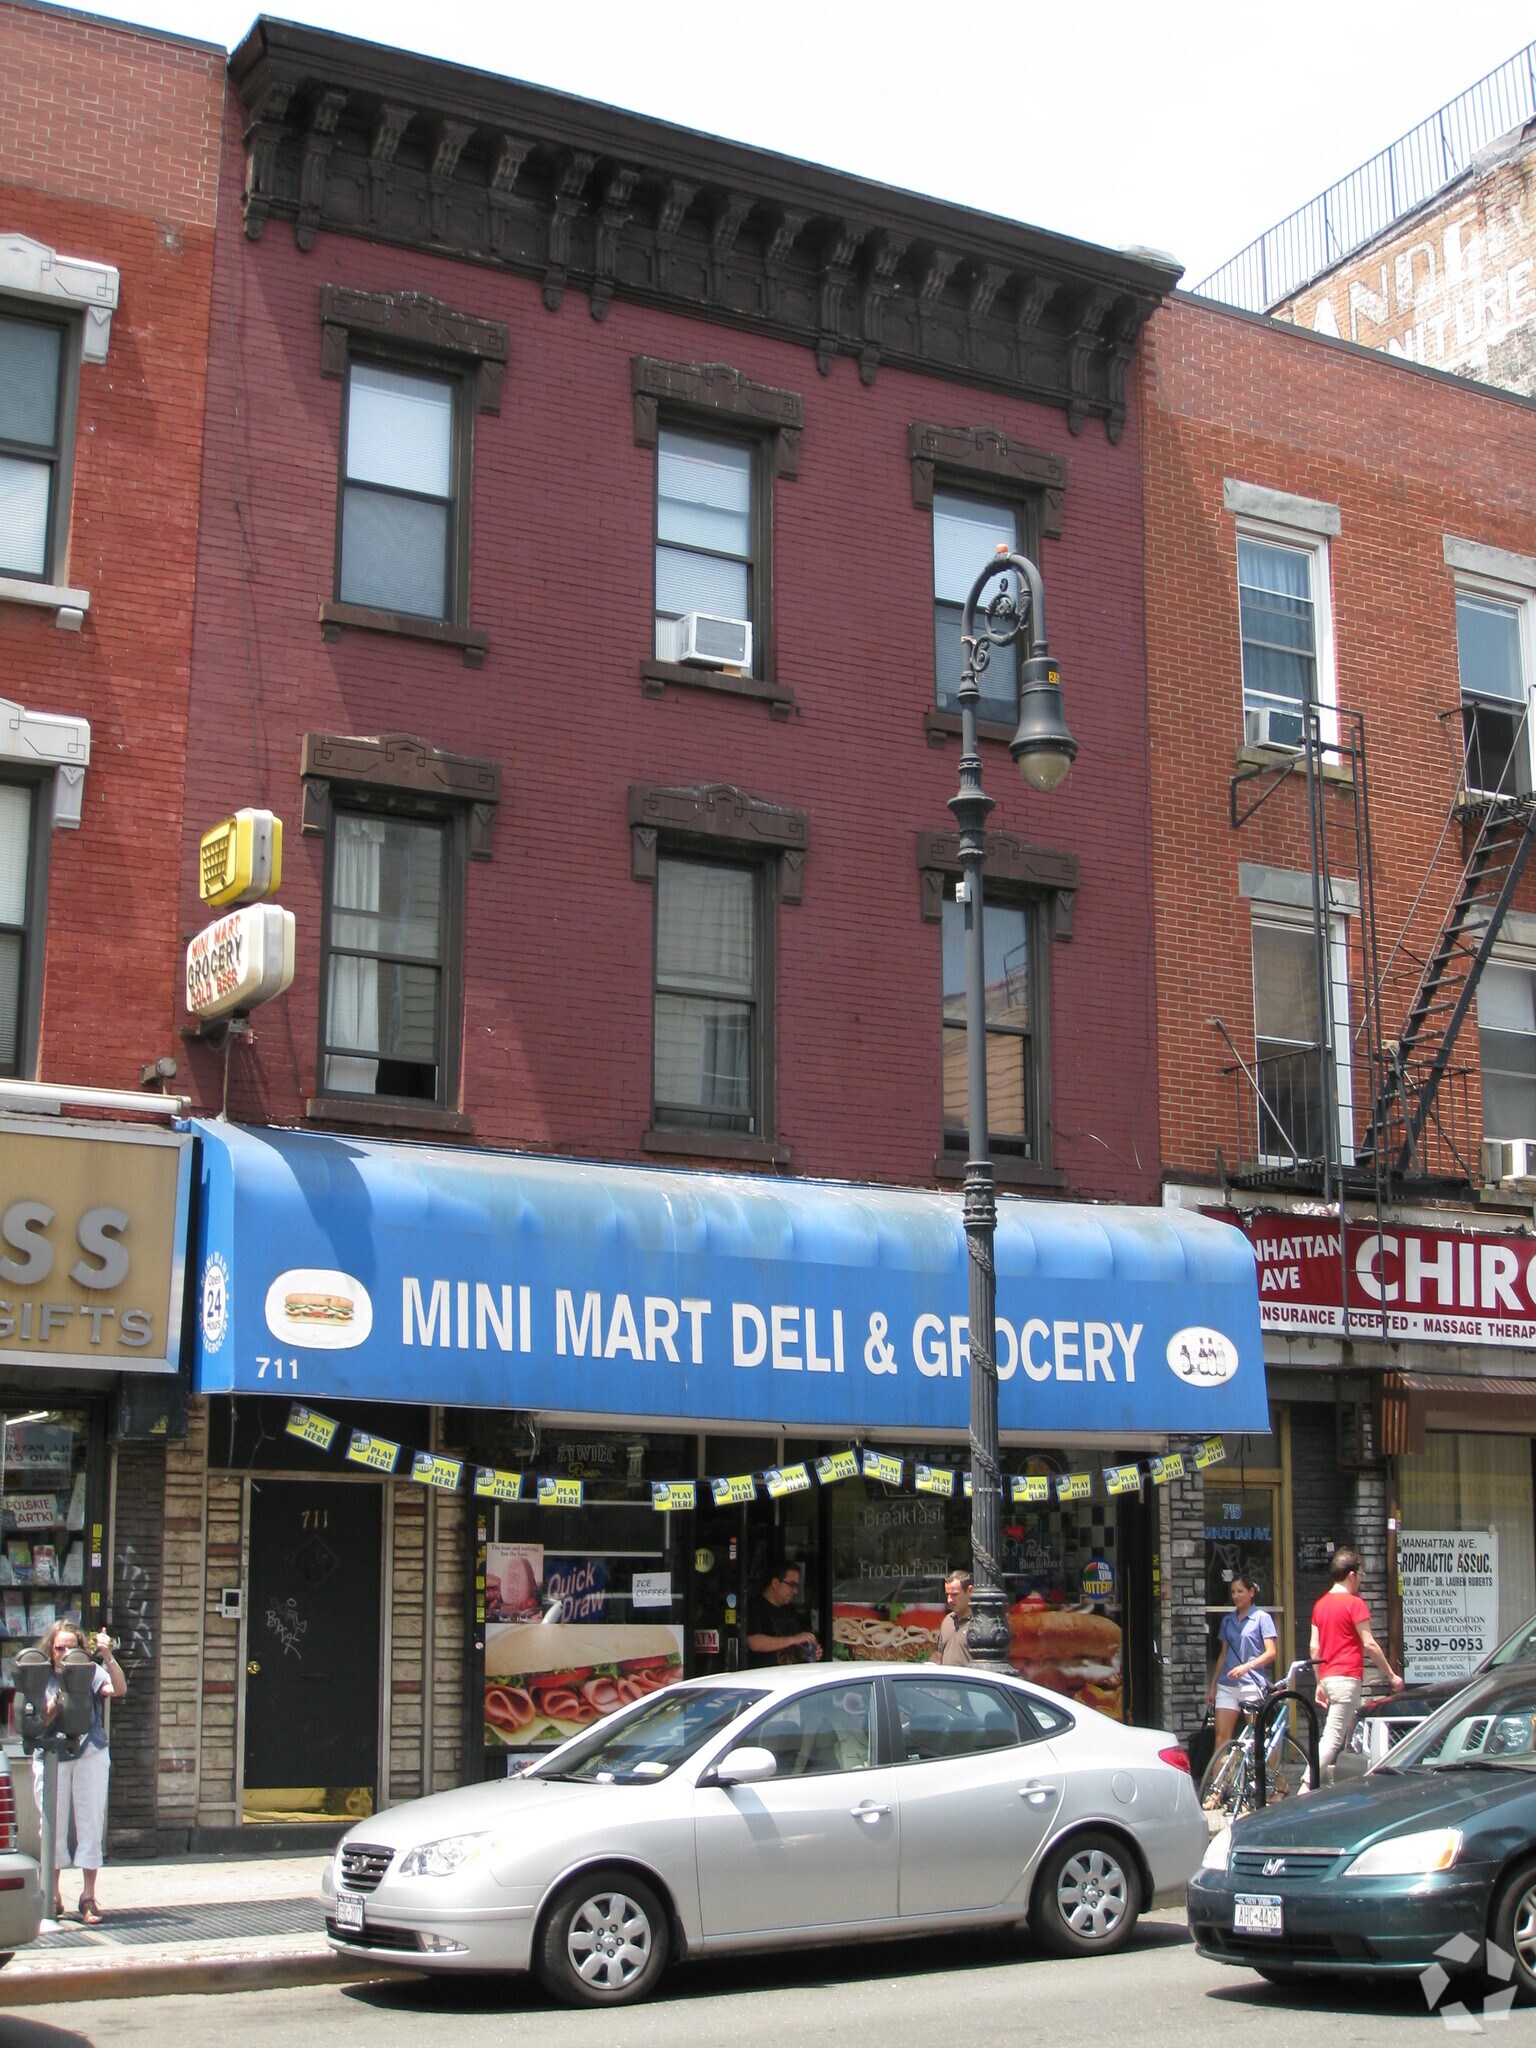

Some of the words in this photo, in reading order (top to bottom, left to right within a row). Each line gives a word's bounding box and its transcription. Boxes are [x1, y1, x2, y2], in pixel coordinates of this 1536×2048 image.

[192, 933, 209, 957] MINI
[214, 915, 241, 943] MART
[188, 934, 243, 989] GROCERY
[1355, 1234, 1536, 1312] CHIR
[1261, 1266, 1301, 1292] AVE
[207, 1288, 222, 1318] 24
[1261, 1305, 1336, 1326] NSURANCE
[1423, 1317, 1482, 1337] MASSAGE
[402, 1277, 531, 1353] MINI
[556, 1288, 712, 1364] MART
[732, 1302, 844, 1373] DELI
[864, 1311, 898, 1375] &
[912, 1312, 1144, 1383] GROCERY
[255, 1357, 299, 1380] 711
[308, 1421, 331, 1436] PLAY
[304, 1429, 329, 1447] HERE
[370, 1446, 394, 1460] PLAY
[1206, 1443, 1222, 1454] PLAY
[366, 1454, 392, 1470] HERE
[1207, 1451, 1225, 1462] HERE
[833, 1458, 854, 1469] PLAY
[880, 1463, 899, 1474] PLAY
[1165, 1460, 1181, 1471] PLAY
[434, 1467, 457, 1479] PLAY
[835, 1466, 857, 1477] HERE
[878, 1471, 898, 1483] HERE
[1165, 1468, 1184, 1479] HERE
[431, 1474, 456, 1488] HERE
[496, 1478, 518, 1489] PLAY
[932, 1475, 950, 1486] PLAY
[1120, 1474, 1137, 1483] PLAY
[731, 1482, 751, 1492] PLAY
[931, 1483, 951, 1494] HERE
[1071, 1481, 1088, 1489] PLAY
[1121, 1482, 1139, 1491] HERE
[493, 1487, 517, 1498] HERE
[557, 1487, 579, 1496] PLAY
[671, 1491, 692, 1500] PLAY
[731, 1491, 753, 1501] HERE
[1028, 1491, 1047, 1499] HERE
[1071, 1489, 1090, 1497] HERE
[5, 1500, 51, 1510] POLSKIE
[556, 1496, 579, 1505] HERE
[671, 1500, 693, 1508] HERE
[1222, 1503, 1242, 1519] 715
[16, 1511, 54, 1523] ARTKI
[302, 1510, 329, 1529] 711
[1401, 1538, 1455, 1549] MANHATTAN
[1457, 1538, 1478, 1549] AVE.
[1401, 1552, 1453, 1573] ROPRACTIC
[547, 1561, 596, 1600] Quick
[636, 1579, 652, 1588] ICE
[1422, 1589, 1440, 1597] NECK
[1441, 1589, 1457, 1597] PAIN
[561, 1589, 606, 1624] Draw
[1424, 1598, 1453, 1606] INJURIES
[1429, 1607, 1458, 1615] THERAPY
[1432, 1616, 1486, 1624] COMPENSATION
[1444, 1625, 1482, 1633] ACCIDENTS
[695, 1632, 717, 1646] ATM
